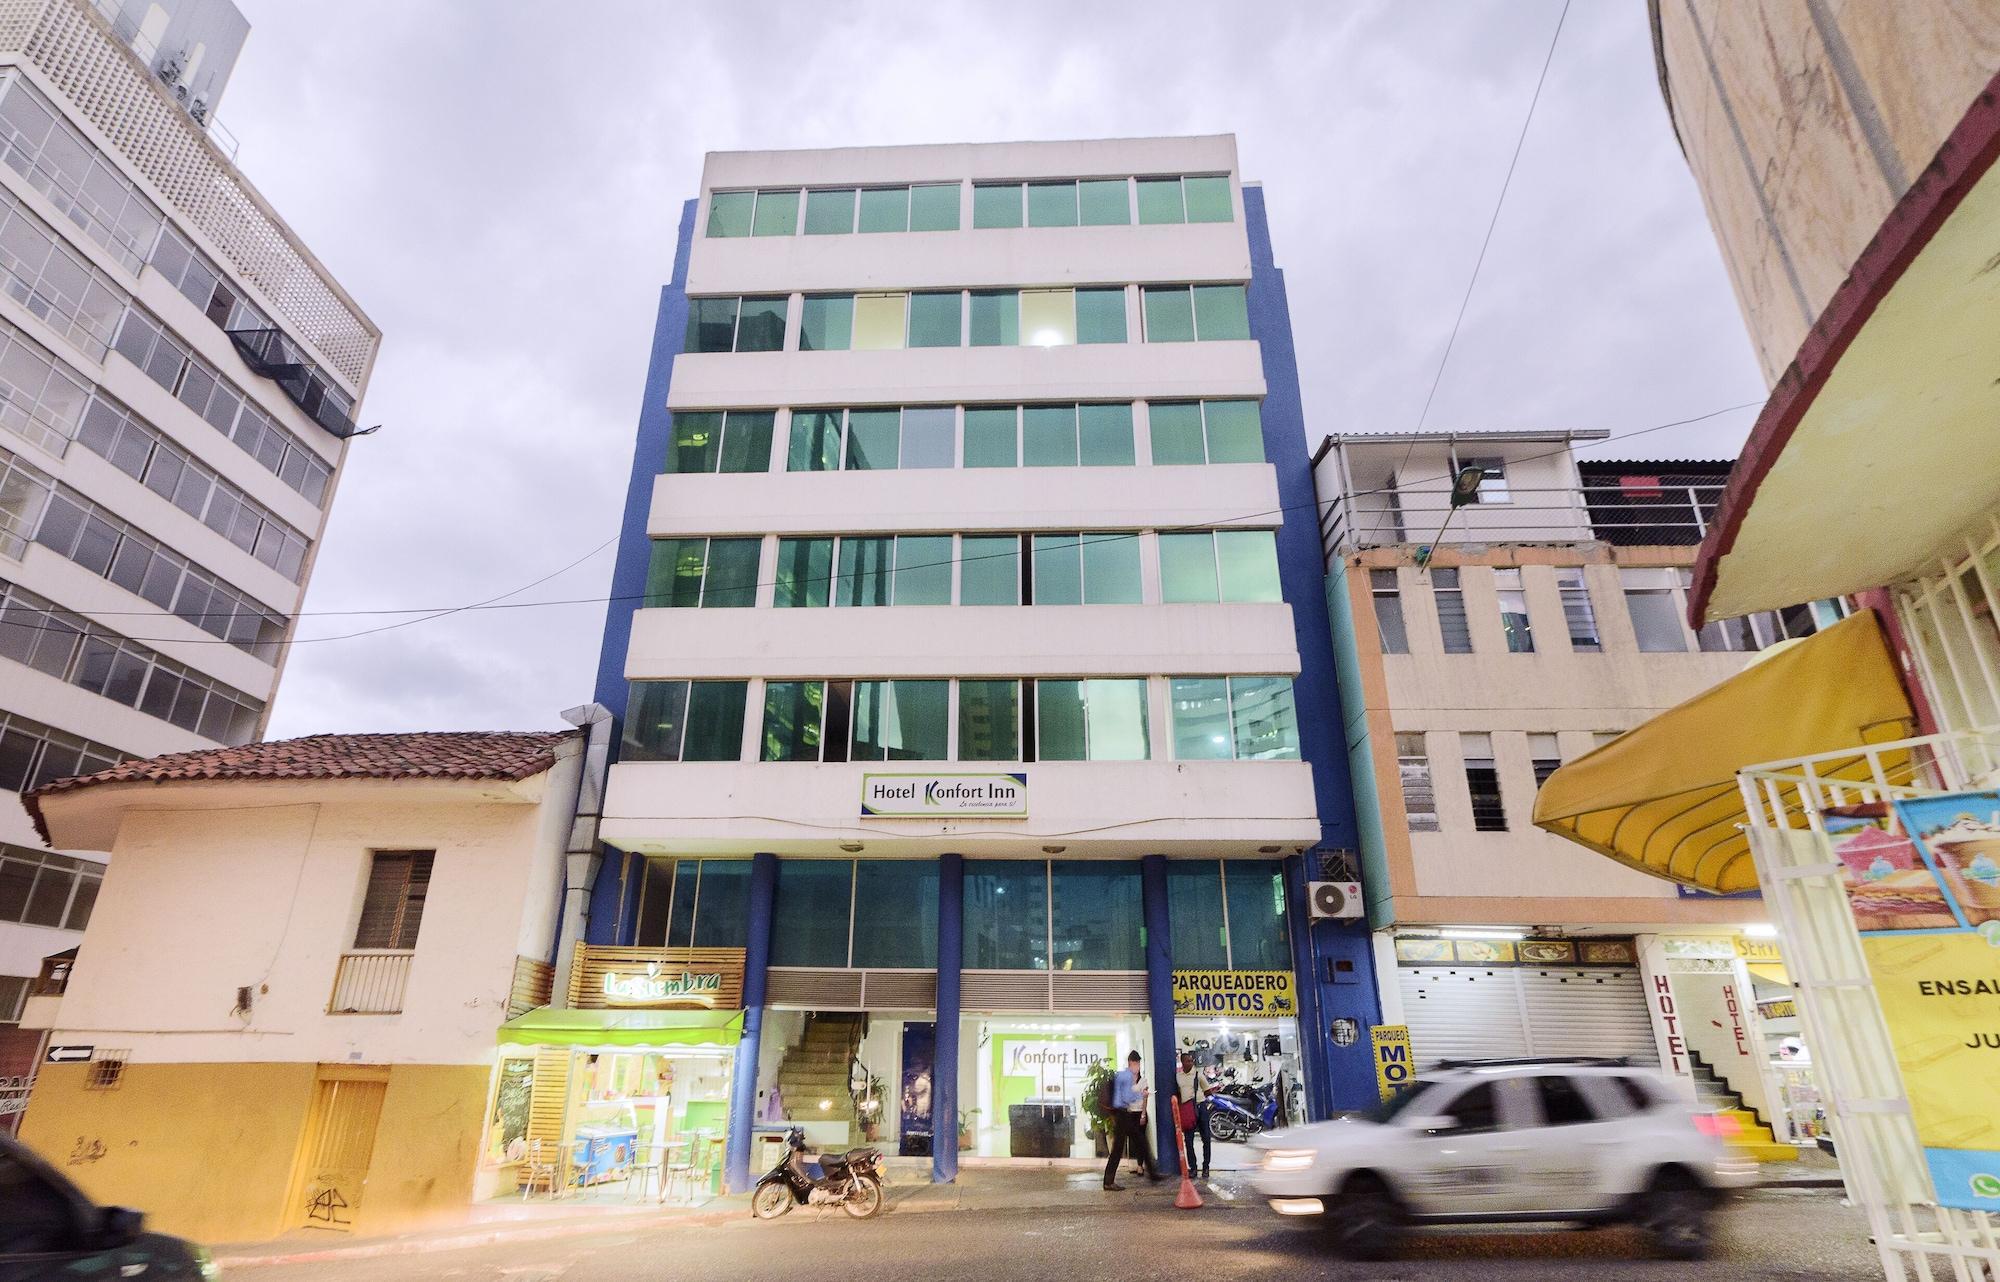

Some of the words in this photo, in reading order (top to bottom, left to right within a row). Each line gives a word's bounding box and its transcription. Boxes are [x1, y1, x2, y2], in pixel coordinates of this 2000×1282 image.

[873, 783, 915, 799] Hotel
[924, 780, 983, 806] Konfort
[989, 783, 1015, 799] Inn
[1172, 975, 1288, 991] PARQUEADERO
[1195, 993, 1264, 1011] MOTOS
[1654, 975, 1689, 1077] HOTEL
[1723, 985, 1749, 1056] HOTEL
[1375, 1030, 1405, 1042] PARQUEO
[1011, 1045, 1069, 1075] Konfort
[1074, 1048, 1100, 1065] Inn
